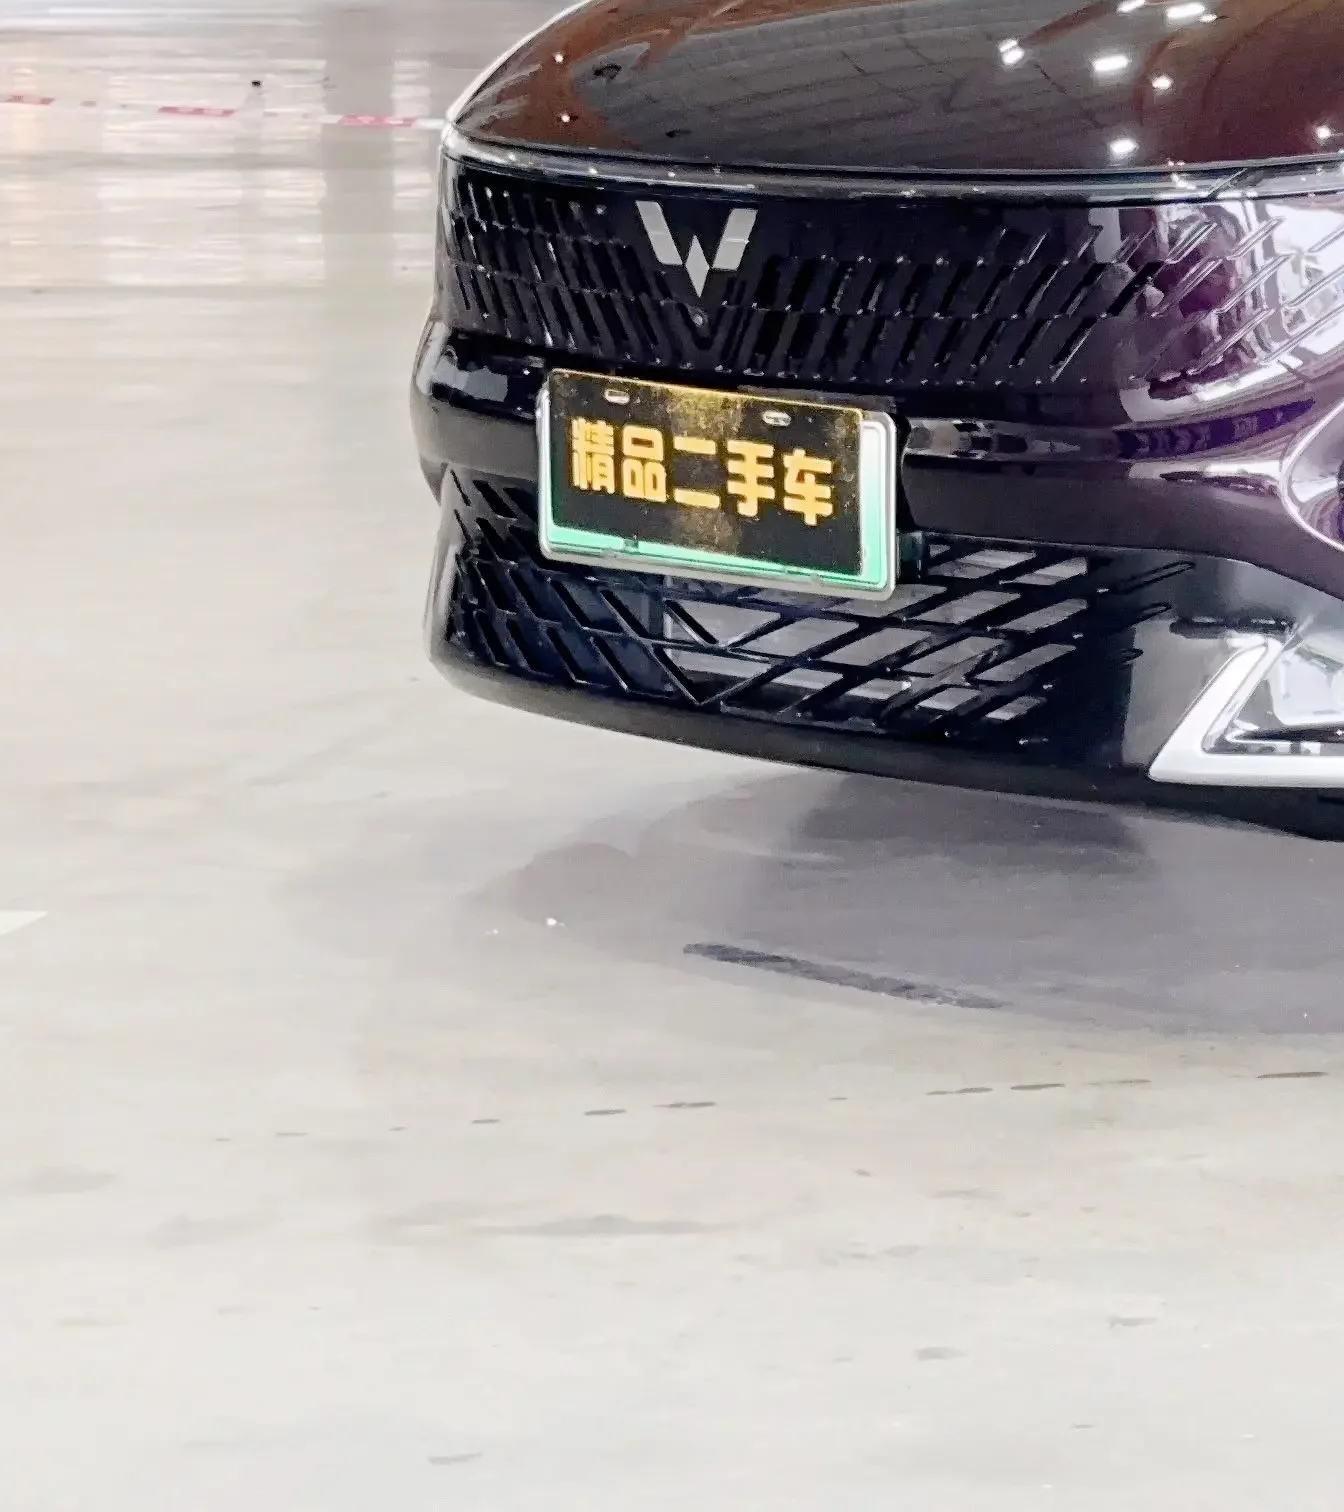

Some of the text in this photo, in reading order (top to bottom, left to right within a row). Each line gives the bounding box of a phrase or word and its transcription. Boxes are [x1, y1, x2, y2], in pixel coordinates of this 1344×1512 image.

[571, 416, 834, 526] 精品二手车
